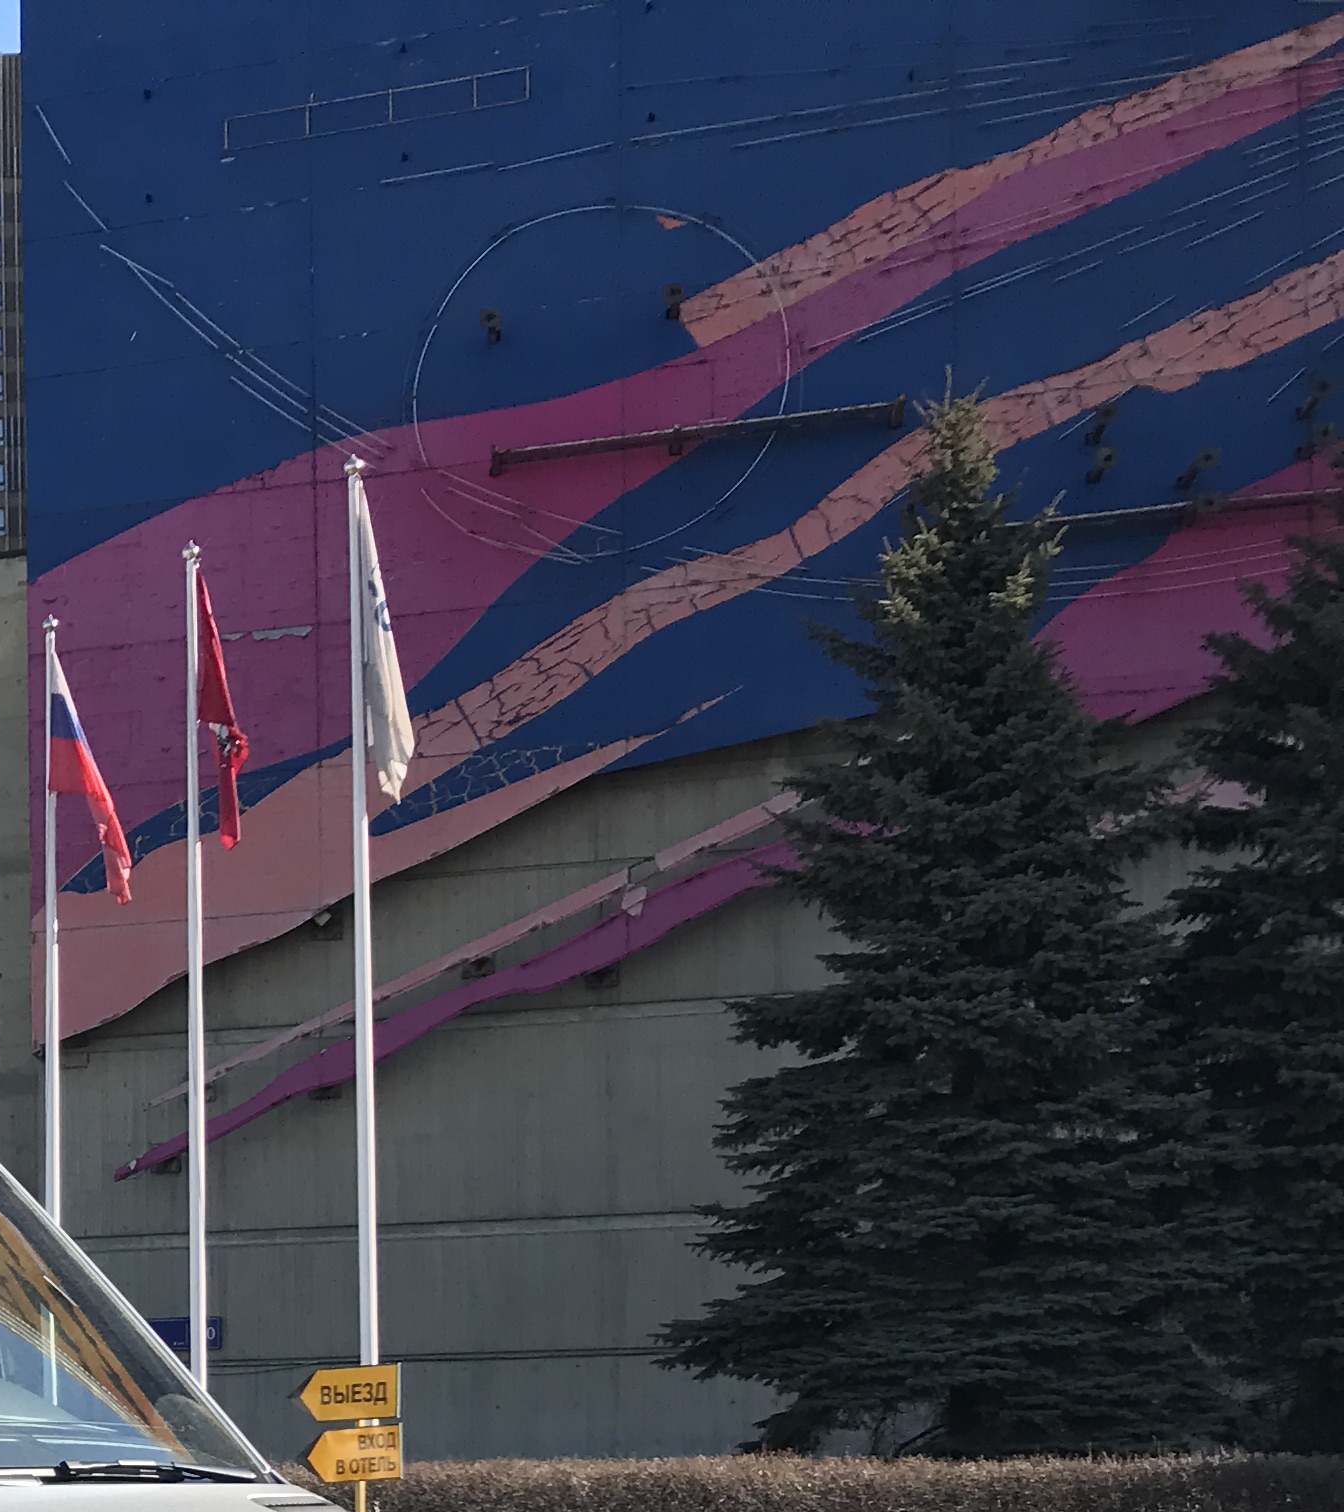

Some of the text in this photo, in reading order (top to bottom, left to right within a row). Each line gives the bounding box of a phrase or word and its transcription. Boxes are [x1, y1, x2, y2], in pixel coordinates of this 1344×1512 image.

[320, 1381, 388, 1406] ВЫЕЗД
[357, 1431, 396, 1451] ВХОД
[336, 1455, 396, 1475] В ОТЕЛЬ
